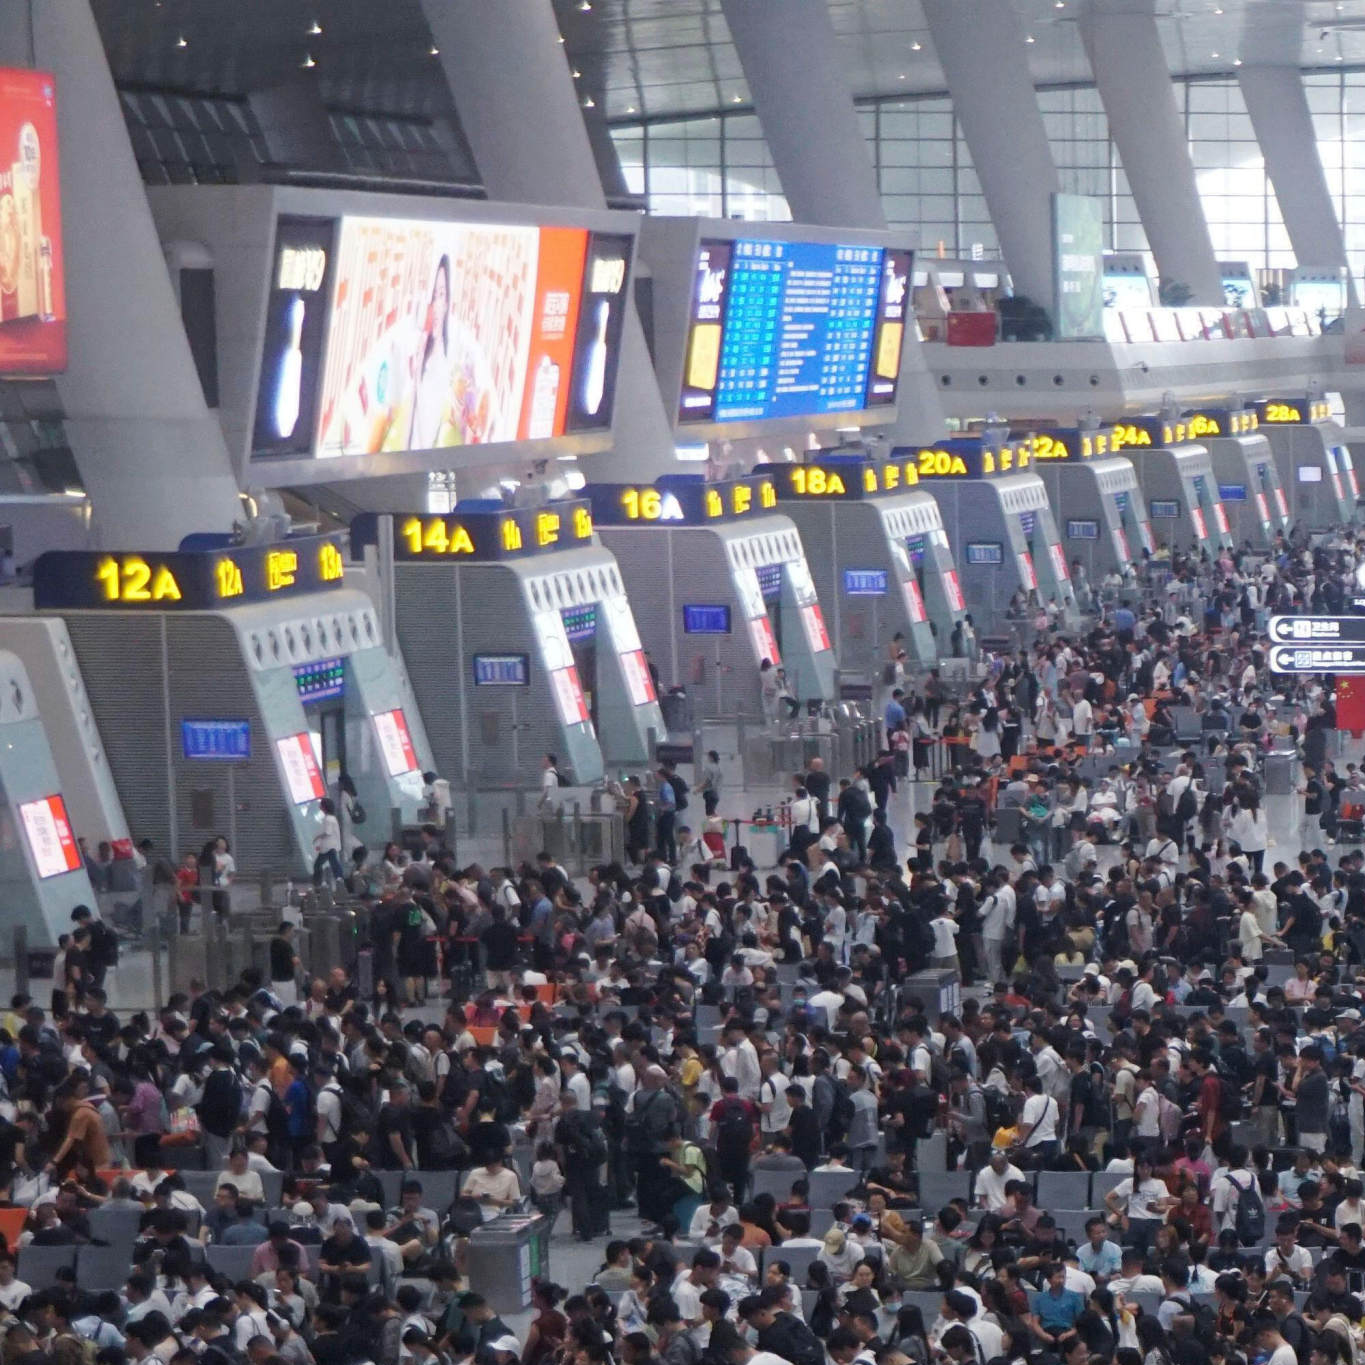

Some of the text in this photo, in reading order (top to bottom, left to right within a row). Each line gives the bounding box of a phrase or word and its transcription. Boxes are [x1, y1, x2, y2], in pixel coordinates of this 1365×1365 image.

[1265, 404, 1302, 422] 28A
[1112, 424, 1151, 445] 24A
[918, 450, 967, 475] 20A
[790, 467, 846, 495] 18A
[621, 489, 685, 520] 16A
[402, 517, 475, 553] 14A
[95, 556, 182, 600] 12A
[217, 557, 244, 598] 12A
